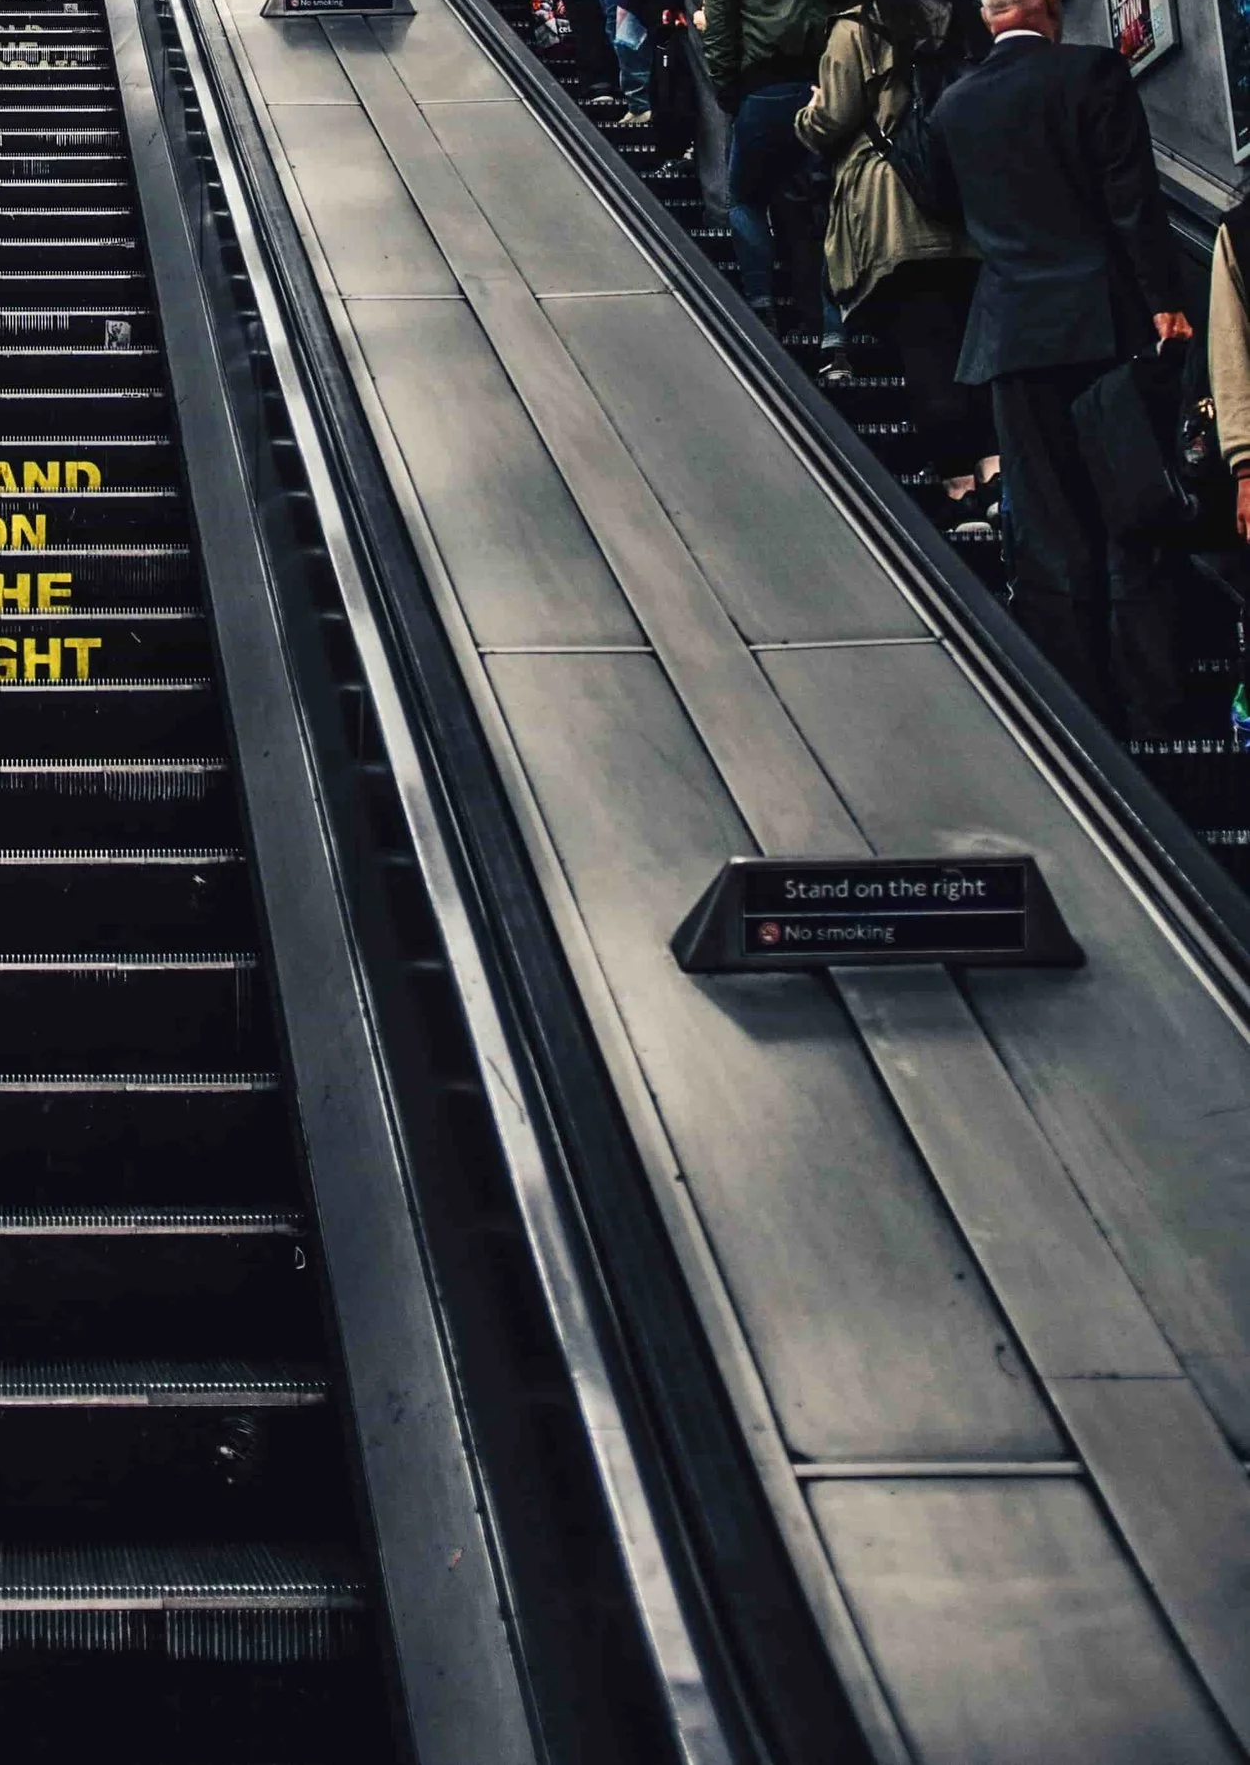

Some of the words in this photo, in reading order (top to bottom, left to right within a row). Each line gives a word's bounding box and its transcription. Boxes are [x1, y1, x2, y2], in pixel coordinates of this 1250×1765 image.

[313, 0, 344, 8] smoking
[784, 879, 849, 899] Stand
[855, 883, 883, 898] on
[888, 879, 927, 897] the
[933, 878, 986, 901] right
[784, 926, 812, 941] No
[817, 924, 895, 944] smoking
